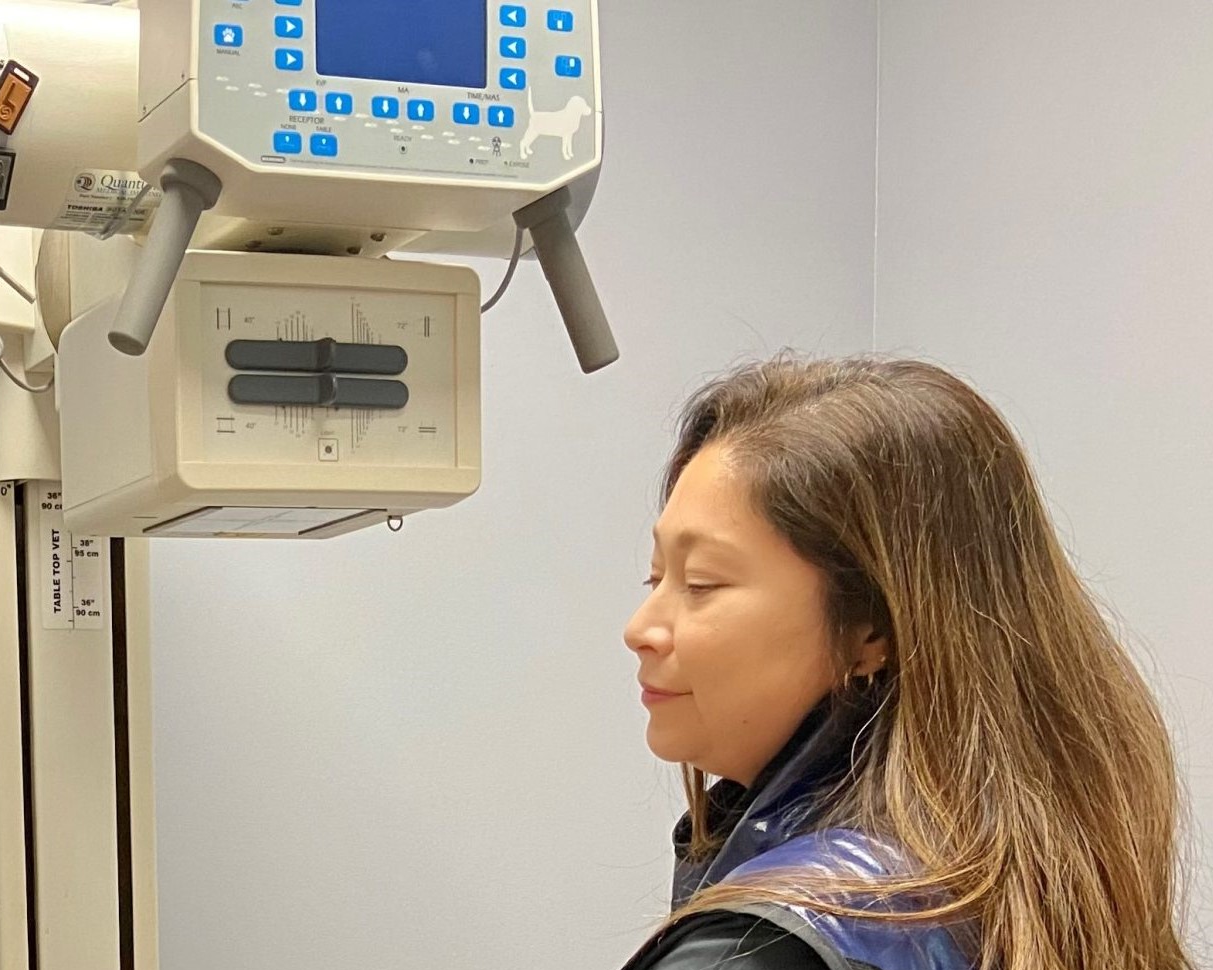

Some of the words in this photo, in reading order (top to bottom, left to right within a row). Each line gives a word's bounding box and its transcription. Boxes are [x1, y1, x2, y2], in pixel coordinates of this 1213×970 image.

[397, 86, 410, 94] MA
[289, 115, 325, 124] RECEPTOR
[68, 204, 103, 212] TOSHIBA
[52, 529, 60, 551] VET
[74, 549, 85, 557] 95
[52, 554, 60, 576] TOP
[53, 579, 61, 614] TABLE
